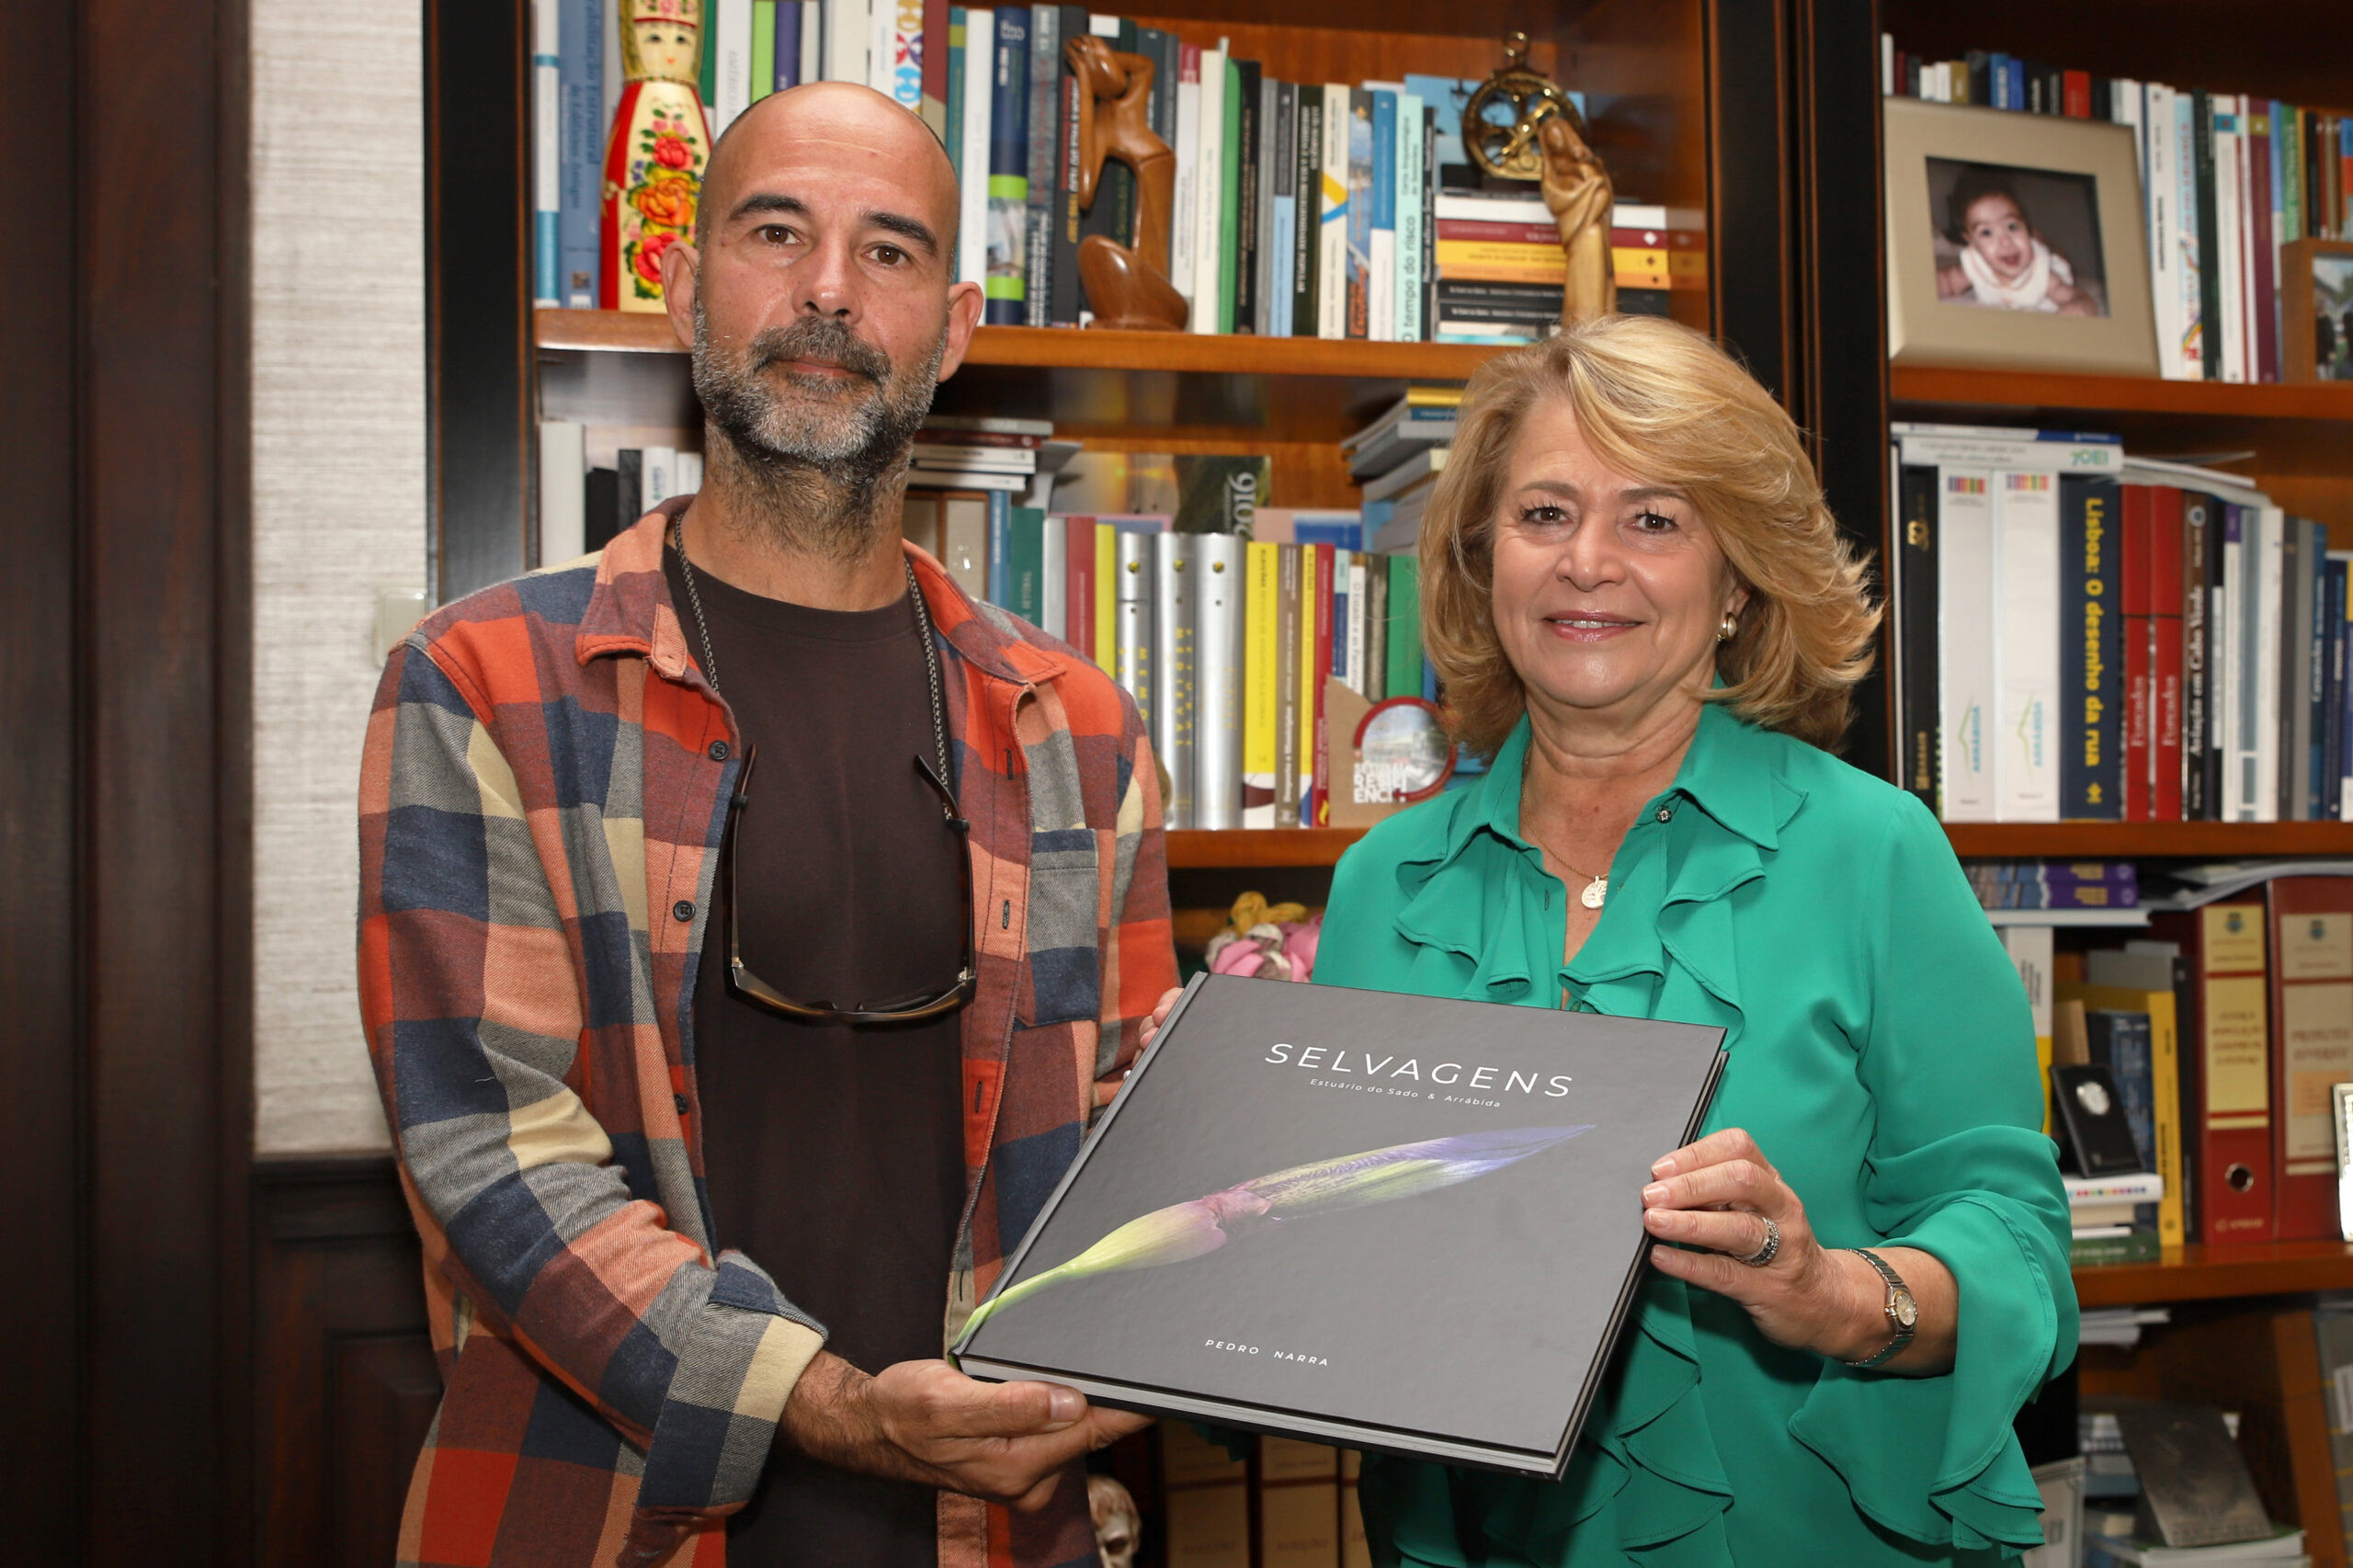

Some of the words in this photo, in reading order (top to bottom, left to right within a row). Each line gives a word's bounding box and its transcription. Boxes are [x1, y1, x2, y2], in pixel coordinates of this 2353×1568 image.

[1402, 215, 1416, 251] risco
[1402, 256, 1415, 274] do
[1402, 280, 1418, 327] tempo
[2086, 498, 2105, 574] Lisboa:
[2086, 579, 2104, 596] O
[2188, 585, 2204, 628] Verde
[1352, 636, 1358, 645] as
[2085, 601, 2105, 691] desenho
[2188, 629, 2203, 671] Cabo
[1176, 628, 1184, 746] MEDIEVAL
[2191, 672, 2203, 696] em
[2086, 696, 2104, 723] da
[2130, 676, 2146, 747] Forcados
[2161, 675, 2177, 746] Forcados
[2086, 730, 2101, 767] rua
[1264, 1043, 1573, 1097] SELVAGENS
[1310, 1078, 1362, 1091] Estuário
[1367, 1085, 1382, 1094] do
[1388, 1087, 1418, 1098] Sado
[1443, 1095, 1501, 1108] Arrábida
[1205, 1339, 1259, 1355] PEDRO
[1273, 1350, 1328, 1367] NARRA
